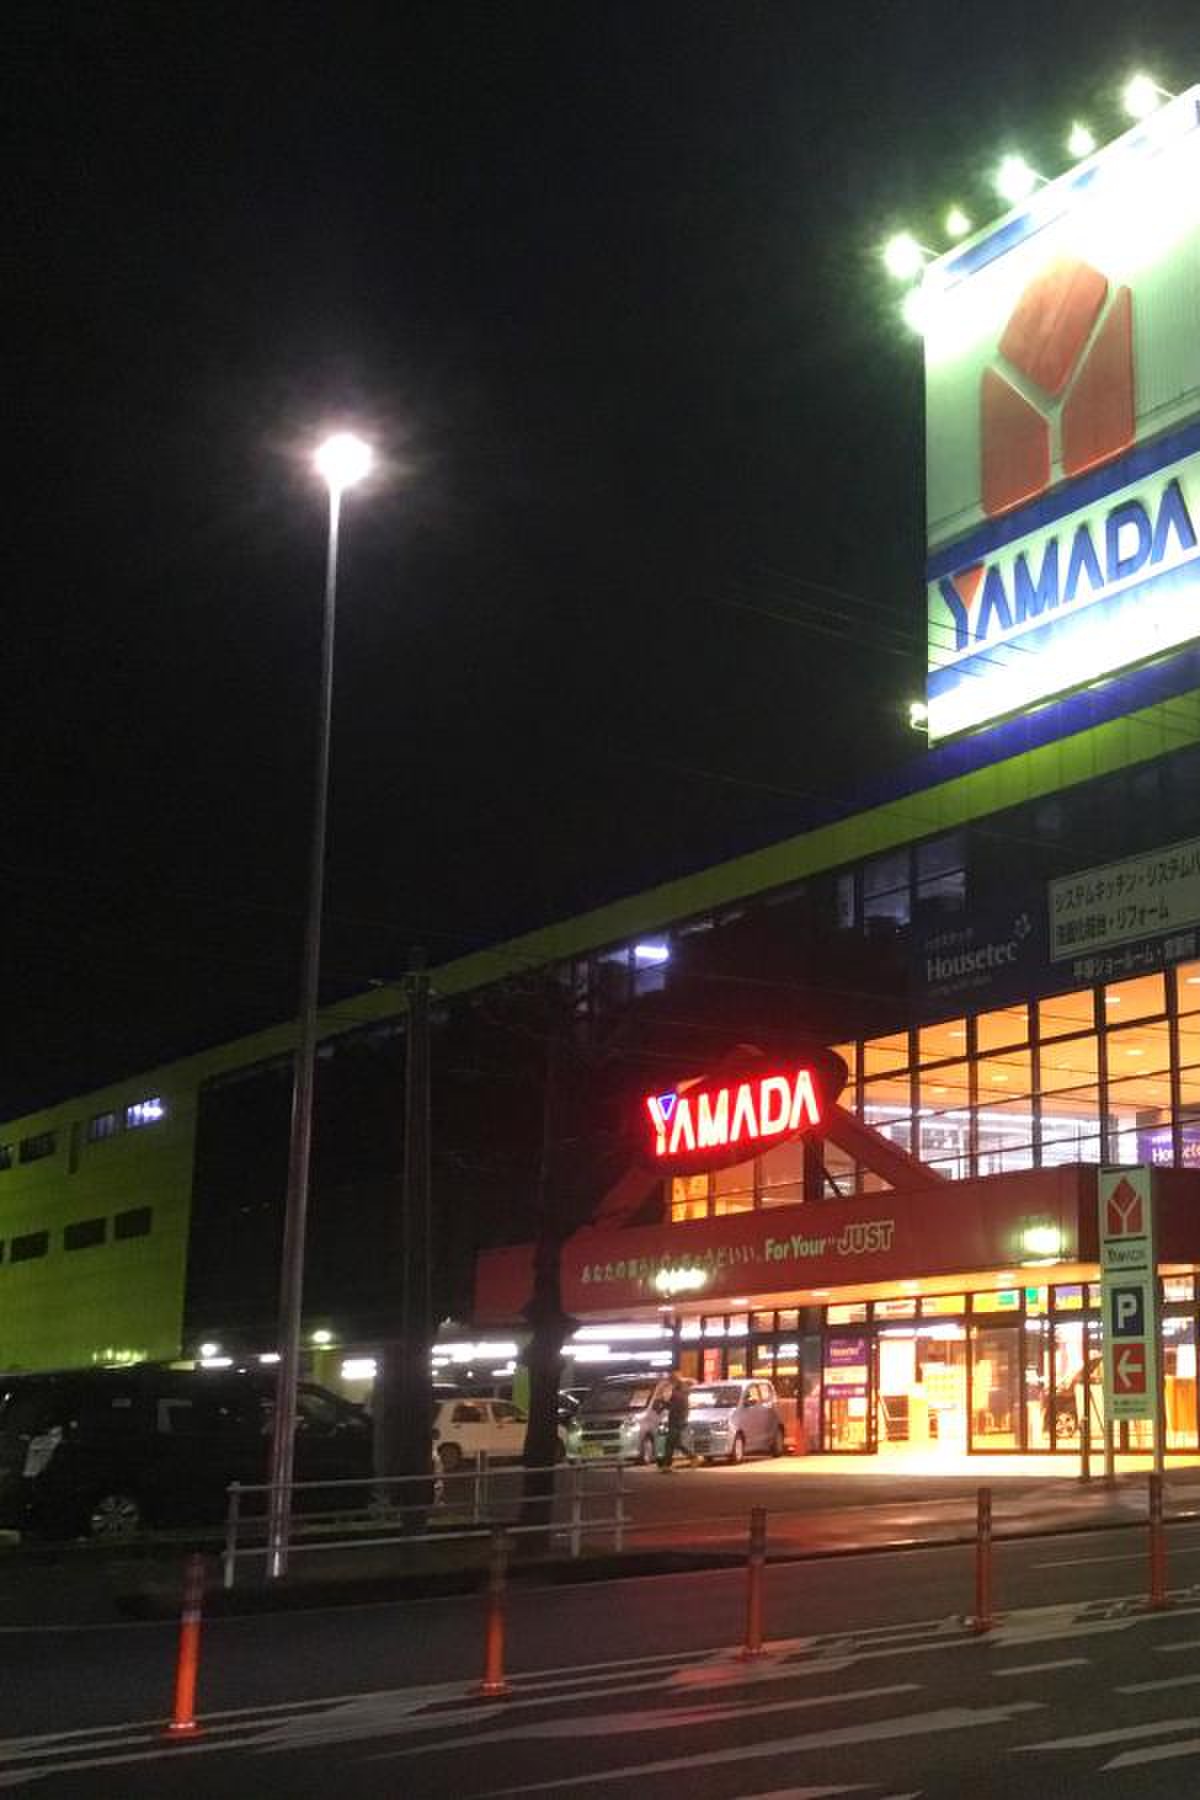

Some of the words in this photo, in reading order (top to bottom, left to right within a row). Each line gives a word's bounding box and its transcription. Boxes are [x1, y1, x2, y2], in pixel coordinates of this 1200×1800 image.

[937, 477, 1198, 652] YAMADA
[927, 941, 1019, 982] Housetec
[647, 1070, 821, 1156] YAMADA
[765, 1238, 788, 1262] For
[790, 1234, 827, 1260] Your
